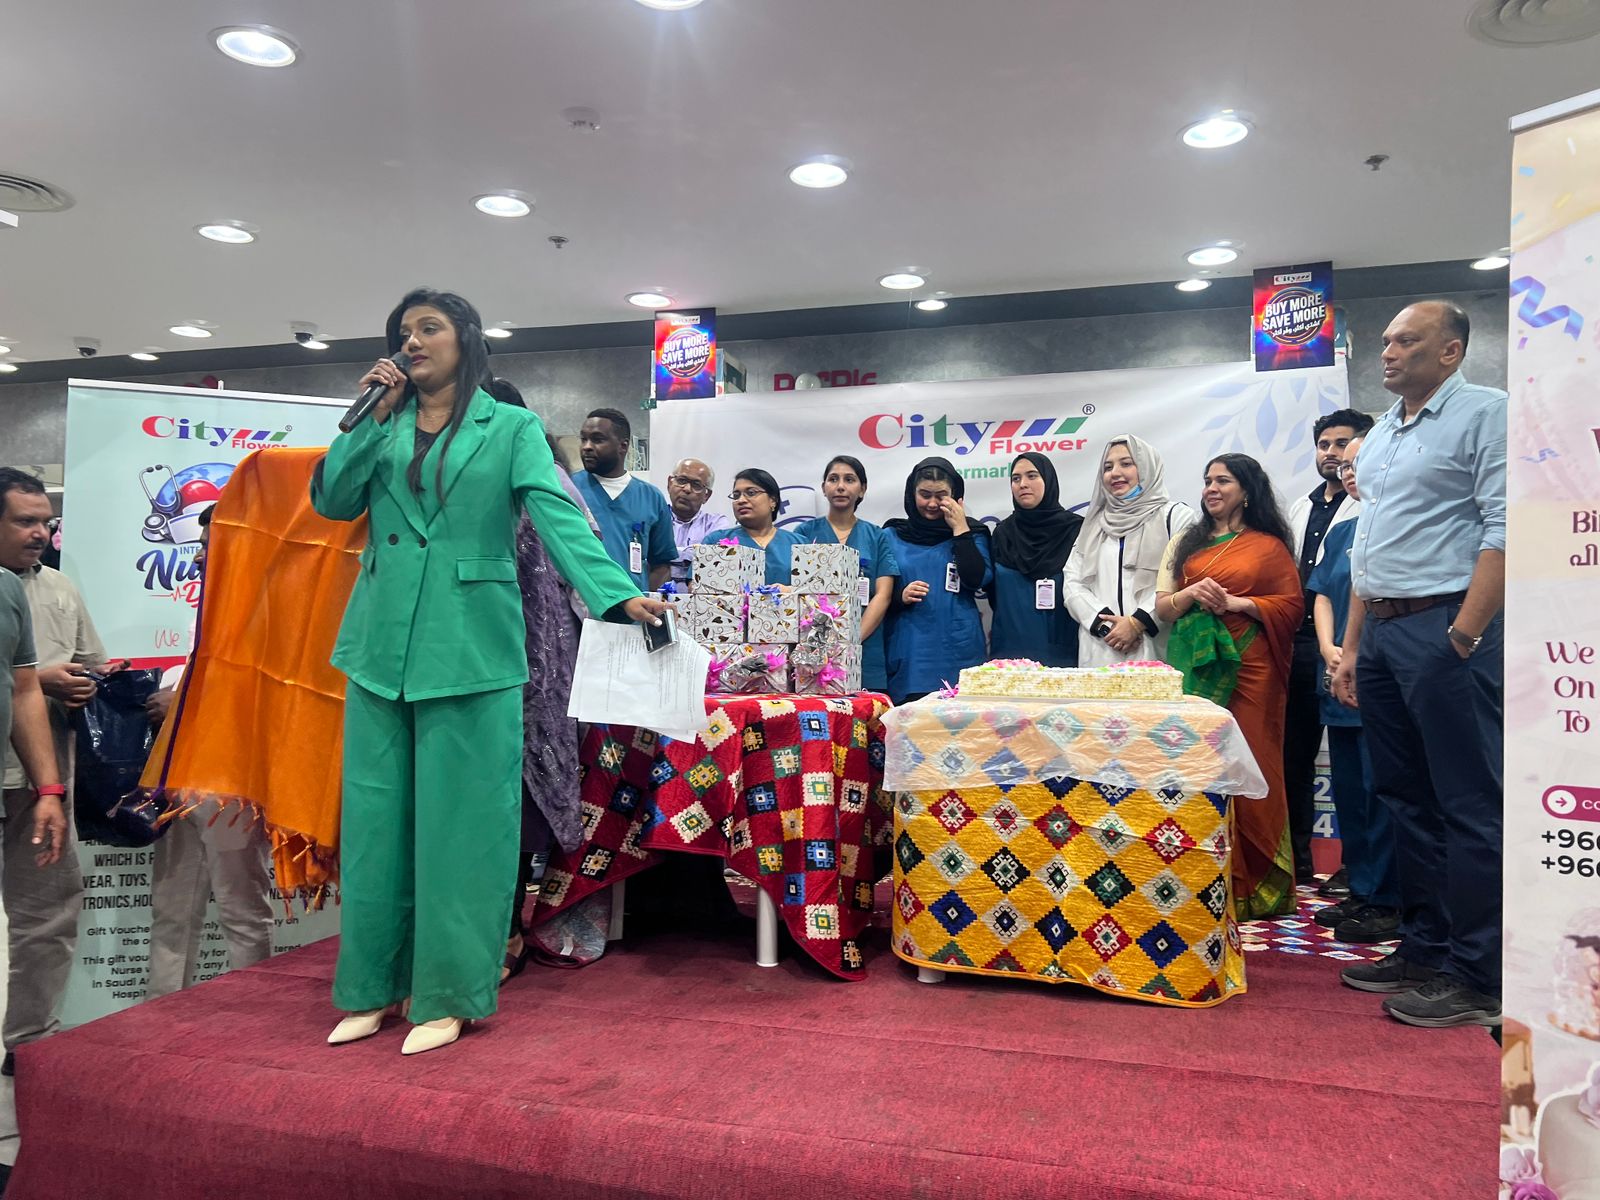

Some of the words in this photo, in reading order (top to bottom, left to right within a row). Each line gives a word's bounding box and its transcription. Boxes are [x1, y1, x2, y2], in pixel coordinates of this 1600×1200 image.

[1265, 301, 1288, 318] BUY
[1289, 293, 1322, 311] MORE
[1262, 312, 1291, 331] SAVE
[1293, 304, 1326, 324] MORE
[664, 338, 682, 353] BUY
[682, 332, 709, 350] MORE
[661, 349, 684, 365] SAVE
[684, 345, 710, 361] MORE
[142, 415, 237, 447] City
[858, 413, 996, 455] City
[990, 438, 1088, 454] Flower
[957, 462, 1011, 479] ermar
[1572, 510, 1600, 534] Bi
[155, 629, 180, 649] We
[1545, 641, 1595, 665] We
[1554, 675, 1595, 699] On
[1557, 709, 1590, 733] To
[94, 852, 133, 867] WHICH
[135, 852, 146, 866] IS
[87, 927, 107, 936] Gift
[122, 938, 139, 946] the
[82, 956, 105, 965] This
[107, 955, 126, 966] gift
[212, 949, 226, 957] for
[111, 967, 142, 975] Nurse
[203, 962, 224, 970] any
[105, 978, 137, 987] Saudi
